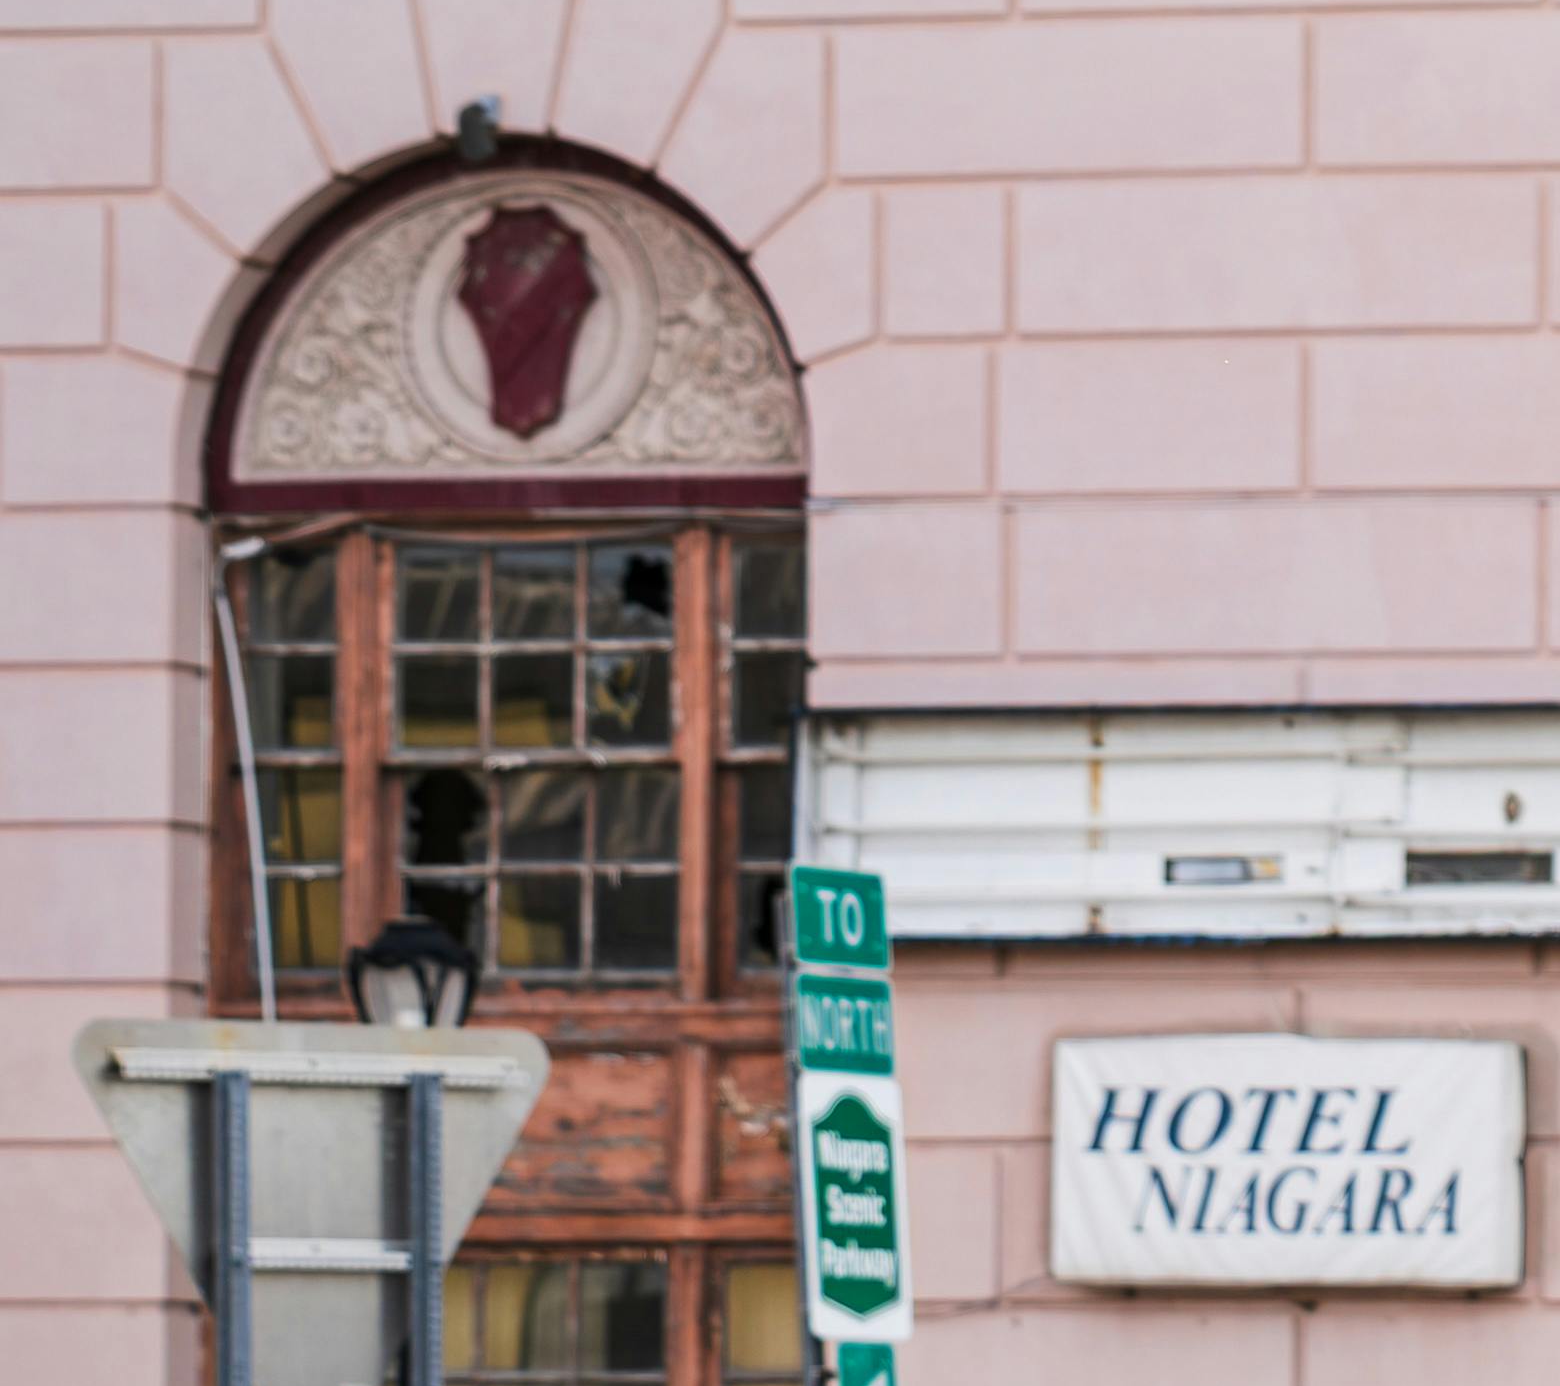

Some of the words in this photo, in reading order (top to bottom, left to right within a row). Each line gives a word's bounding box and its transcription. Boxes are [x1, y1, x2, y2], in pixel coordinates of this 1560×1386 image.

[815, 888, 865, 947] TO
[800, 994, 891, 1054] NORTH
[1084, 1086, 1414, 1156] HOTEL
[825, 1183, 887, 1228] Scenic
[1131, 1163, 1463, 1237] NIAGARA
